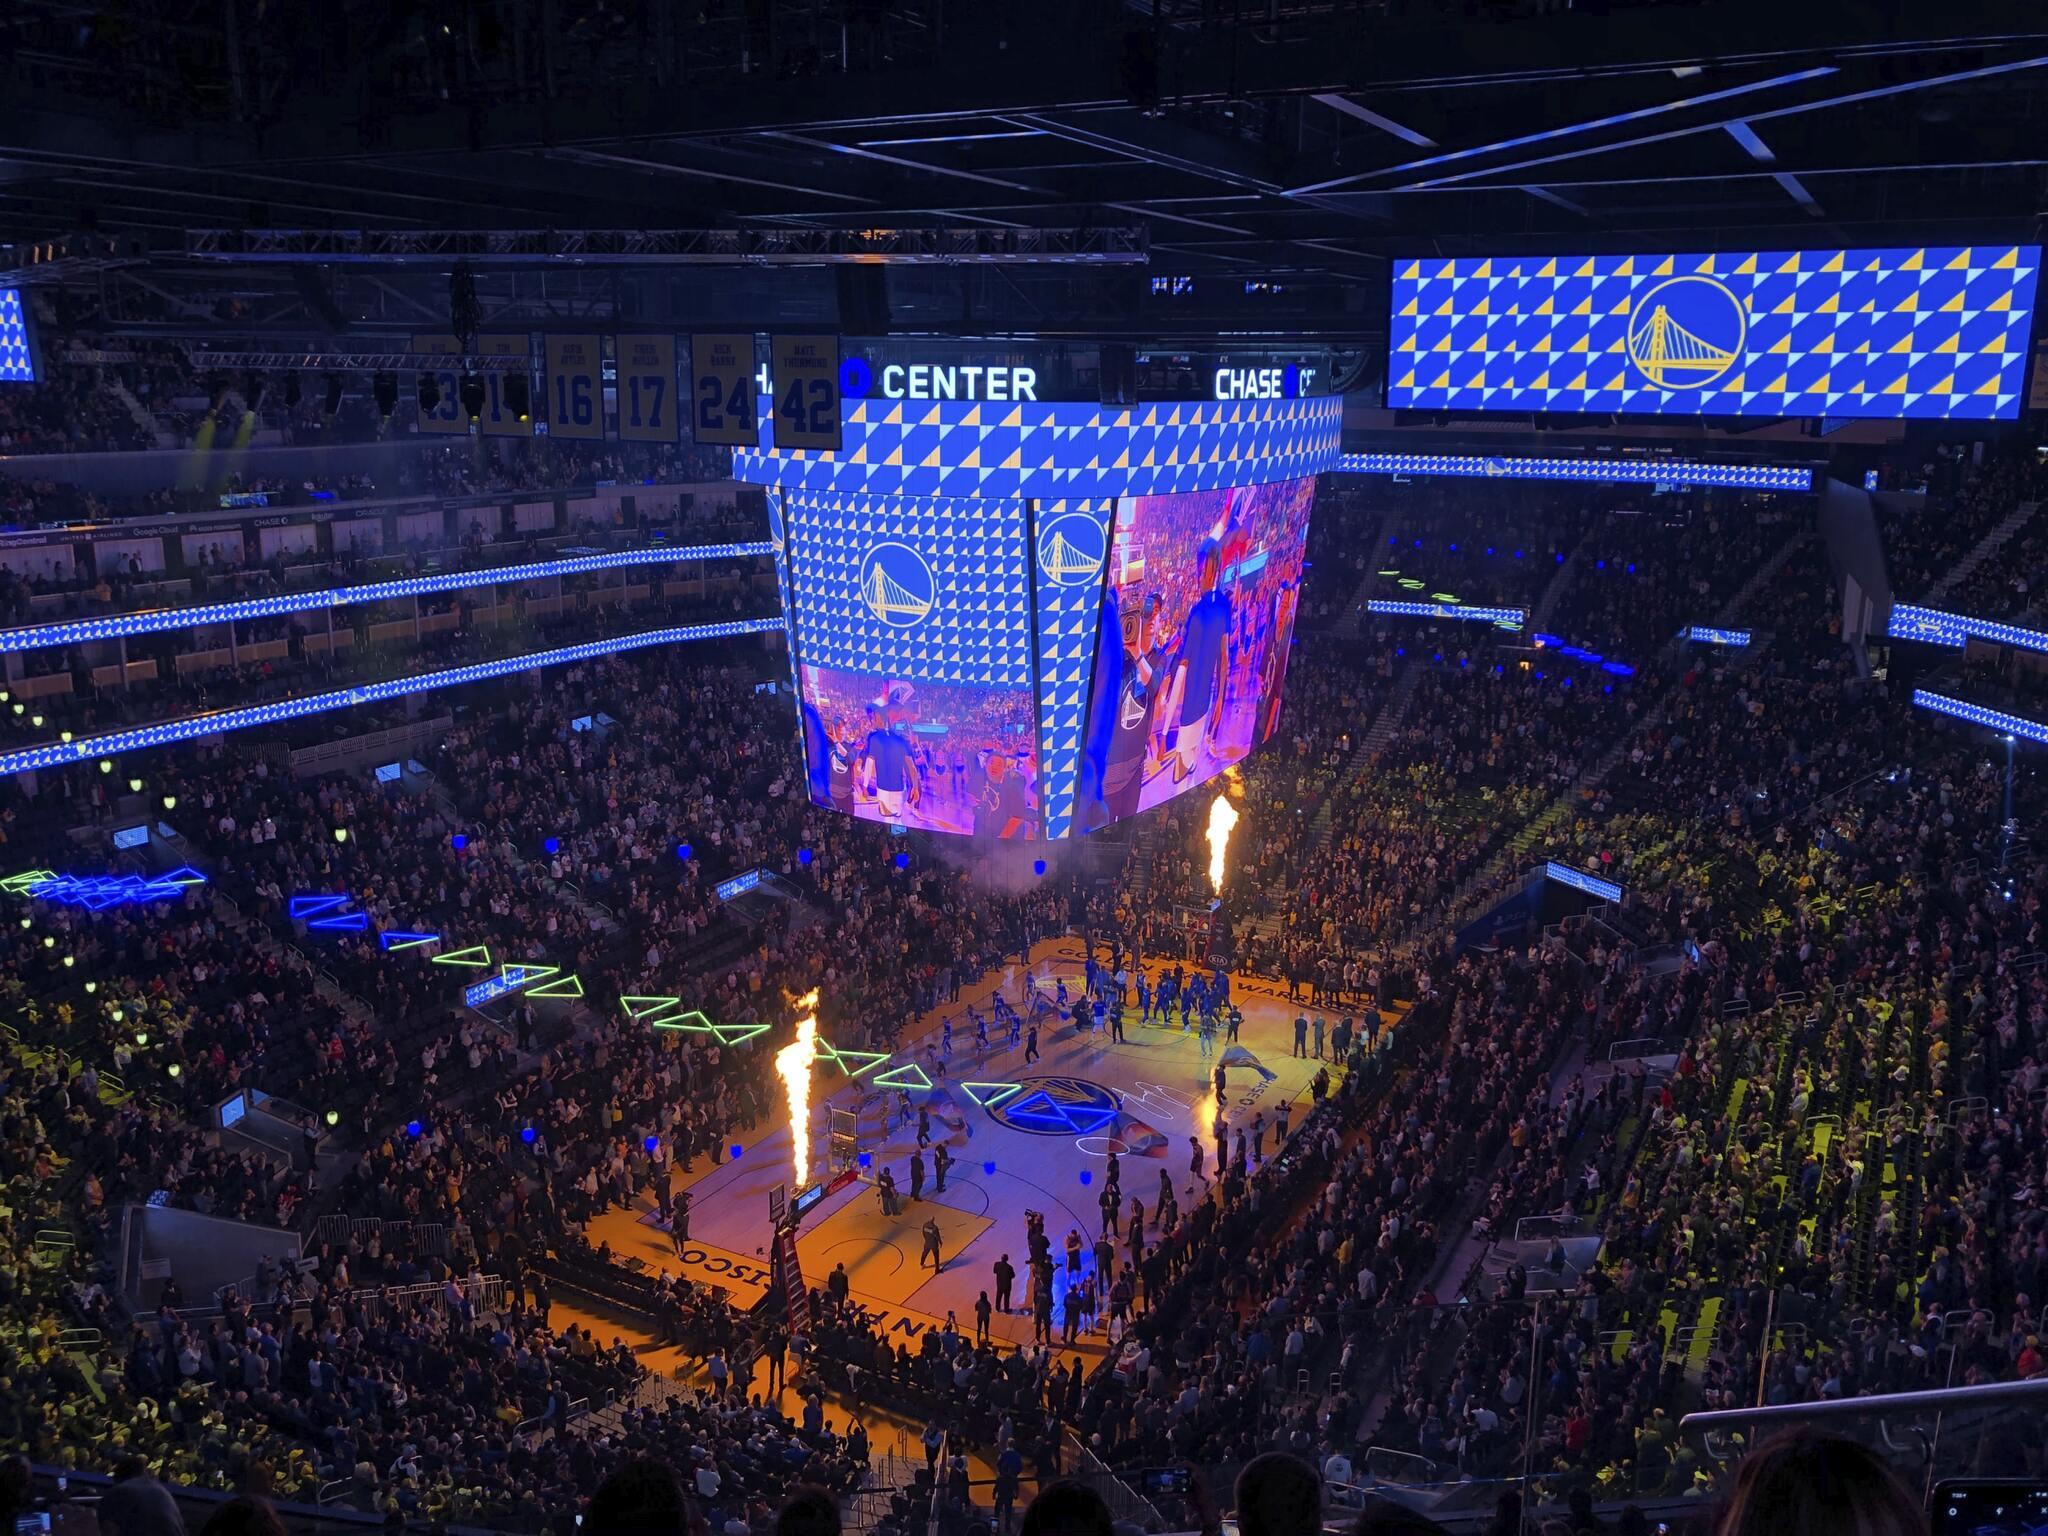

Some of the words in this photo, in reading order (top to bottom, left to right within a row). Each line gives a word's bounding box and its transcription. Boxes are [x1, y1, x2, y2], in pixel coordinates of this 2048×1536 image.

[794, 345, 816, 356] NATE
[556, 374, 593, 426] 16
[628, 375, 666, 428] 17
[882, 364, 1038, 402] CENTER
[1214, 367, 1283, 400] CHASE
[699, 375, 752, 430] 24
[780, 377, 835, 434] 42
[132, 527, 159, 537] Google
[159, 525, 179, 535] Cloud
[254, 517, 281, 527] CHASE
